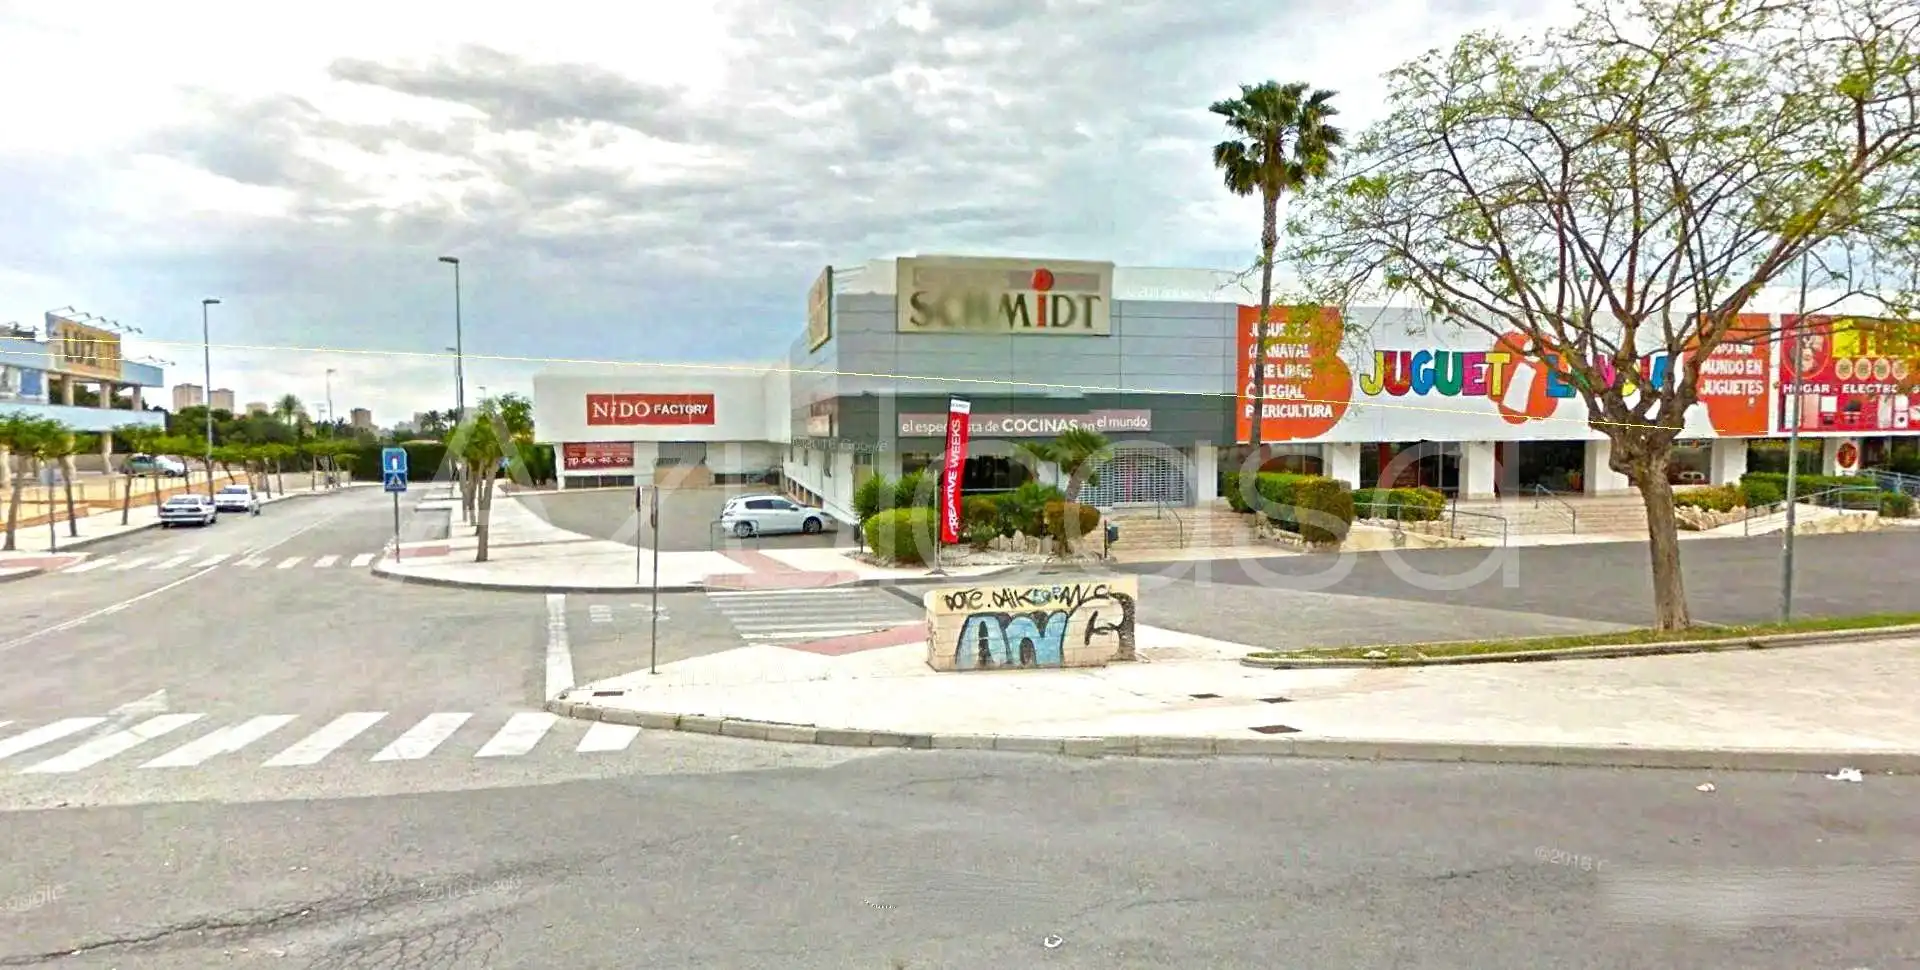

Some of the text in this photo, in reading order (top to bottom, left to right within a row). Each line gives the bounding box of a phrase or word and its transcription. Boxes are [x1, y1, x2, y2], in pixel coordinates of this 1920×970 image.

[1248, 343, 1311, 358] CNAVAL
[1700, 359, 1763, 375] MUNDO EN
[1245, 382, 1305, 399] CLEGIAL
[1701, 379, 1764, 397] JUGUETES
[653, 404, 709, 415] FACTORY
[1245, 404, 1334, 418] PERICULTURA
[902, 420, 913, 433] el
[915, 422, 983, 438] especsta
[984, 420, 998, 433] de
[1002, 418, 1078, 433] COCINAS
[1096, 415, 1106, 428] el
[1108, 415, 1148, 428] mundo
[949, 418, 961, 467] WEEKS
